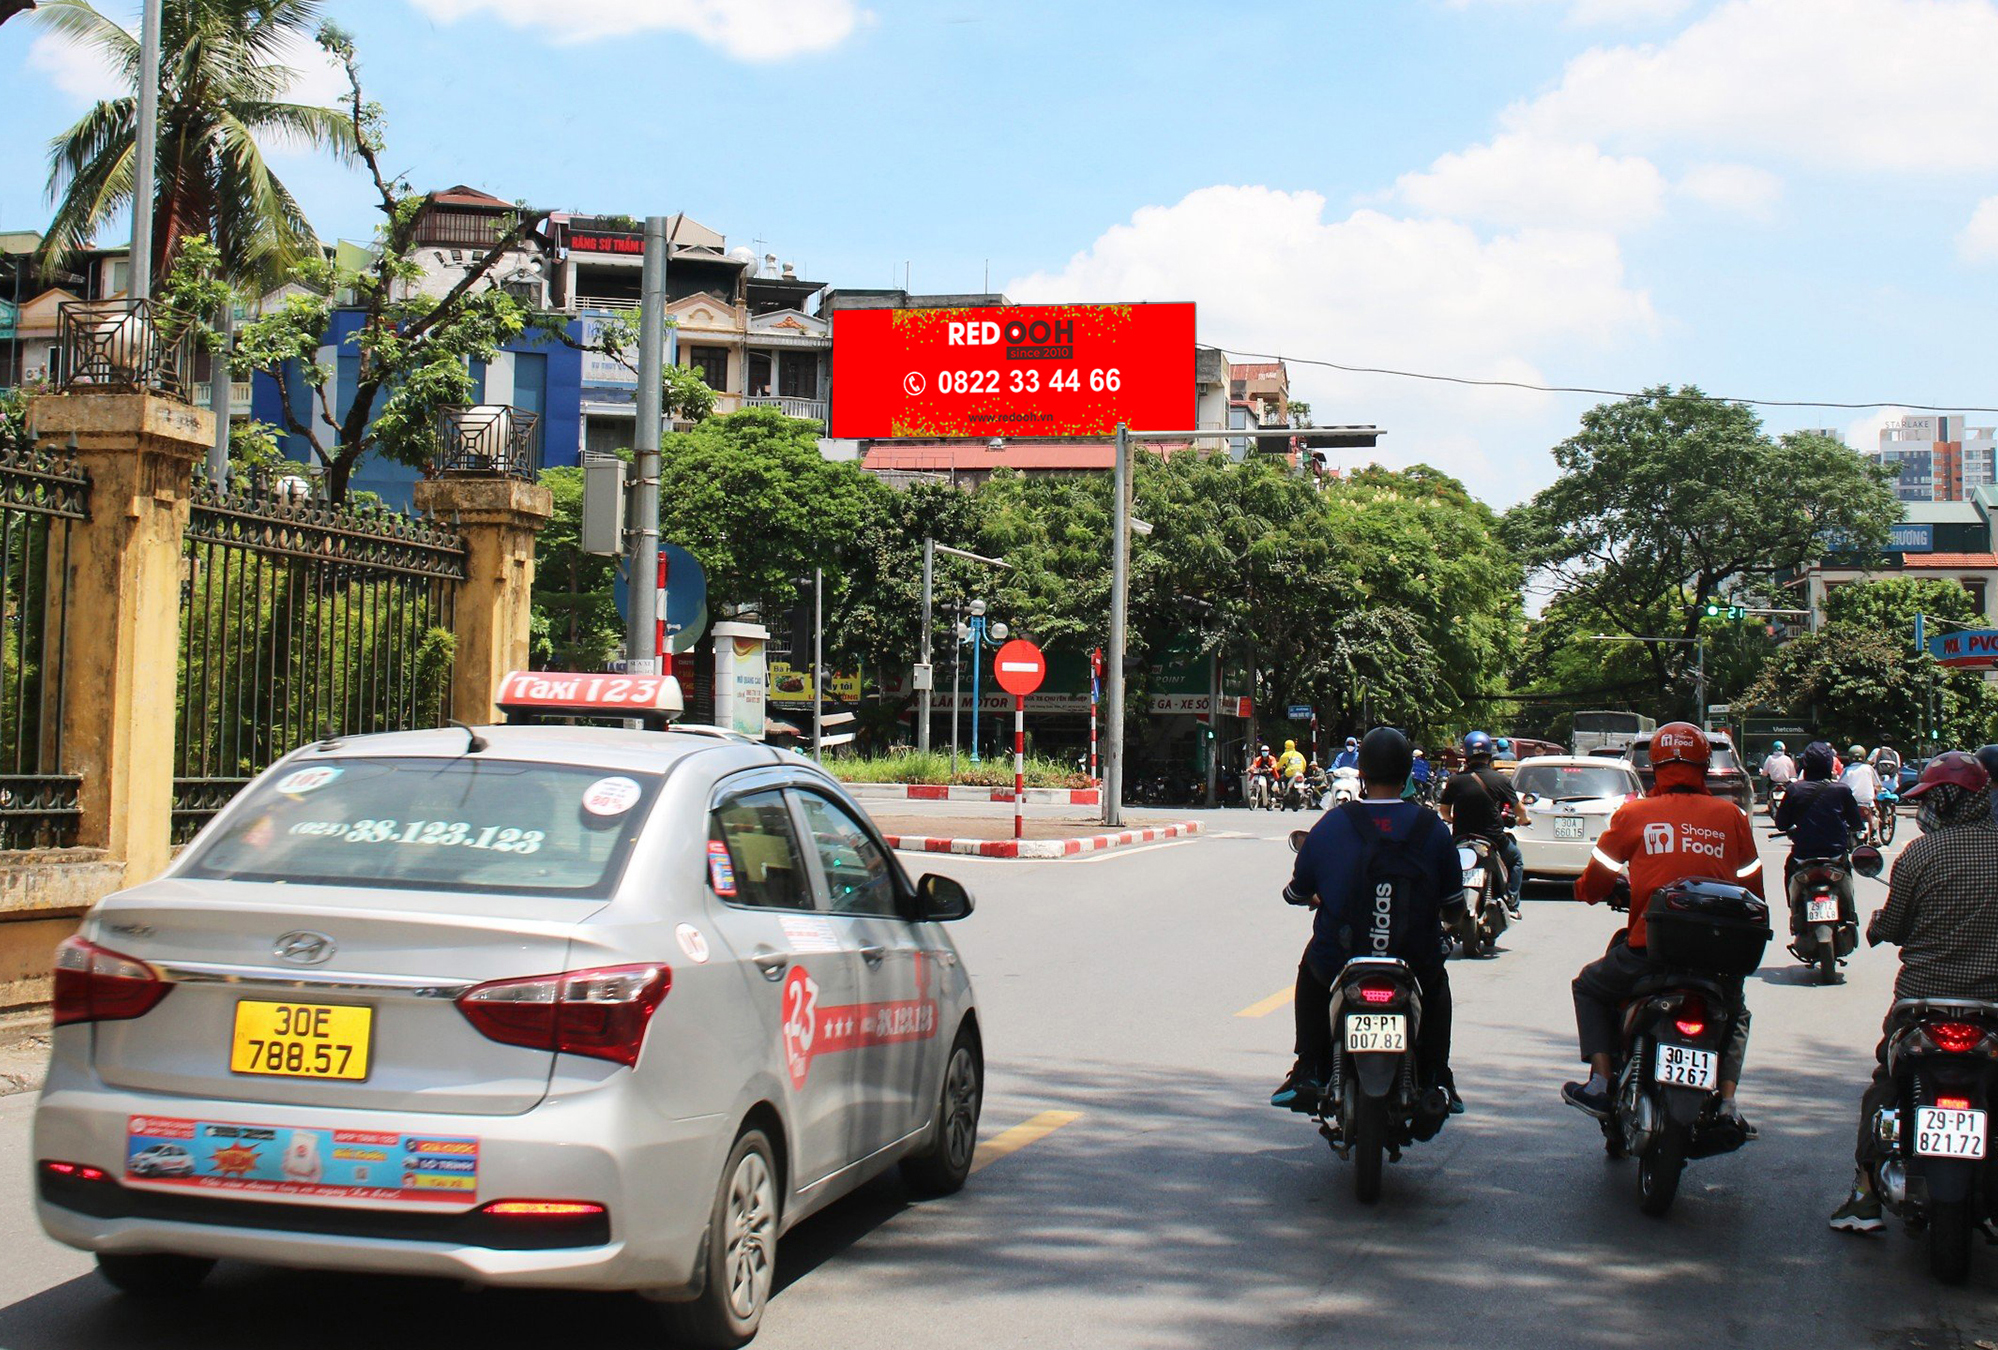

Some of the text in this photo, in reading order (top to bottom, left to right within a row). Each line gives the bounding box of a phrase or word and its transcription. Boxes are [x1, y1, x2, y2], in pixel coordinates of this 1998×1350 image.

[1010, 347, 1069, 358] since 2010
[938, 368, 1121, 394] 0822 33 44 66
[968, 412, 1053, 423] www.redooh.vn
[1727, 607, 1744, 619] 21
[513, 676, 582, 699] Taxi
[584, 679, 659, 703] 123
[1181, 700, 1194, 709] XE
[1673, 739, 1694, 747] Food
[1561, 817, 1577, 828] 30A
[1555, 827, 1583, 838] 660.15
[1680, 823, 1726, 840] Shopee
[1682, 837, 1725, 859] Food
[274, 1006, 331, 1038] 30E
[1355, 1016, 1396, 1032] 29-P1
[1350, 1033, 1402, 1049] 007.82
[248, 1039, 353, 1075] 788.57
[1666, 1047, 1708, 1069] 30-L1
[1664, 1065, 1708, 1086] 3267
[1927, 1111, 1975, 1132] 29-P1
[1919, 1132, 1981, 1155] 821.72
